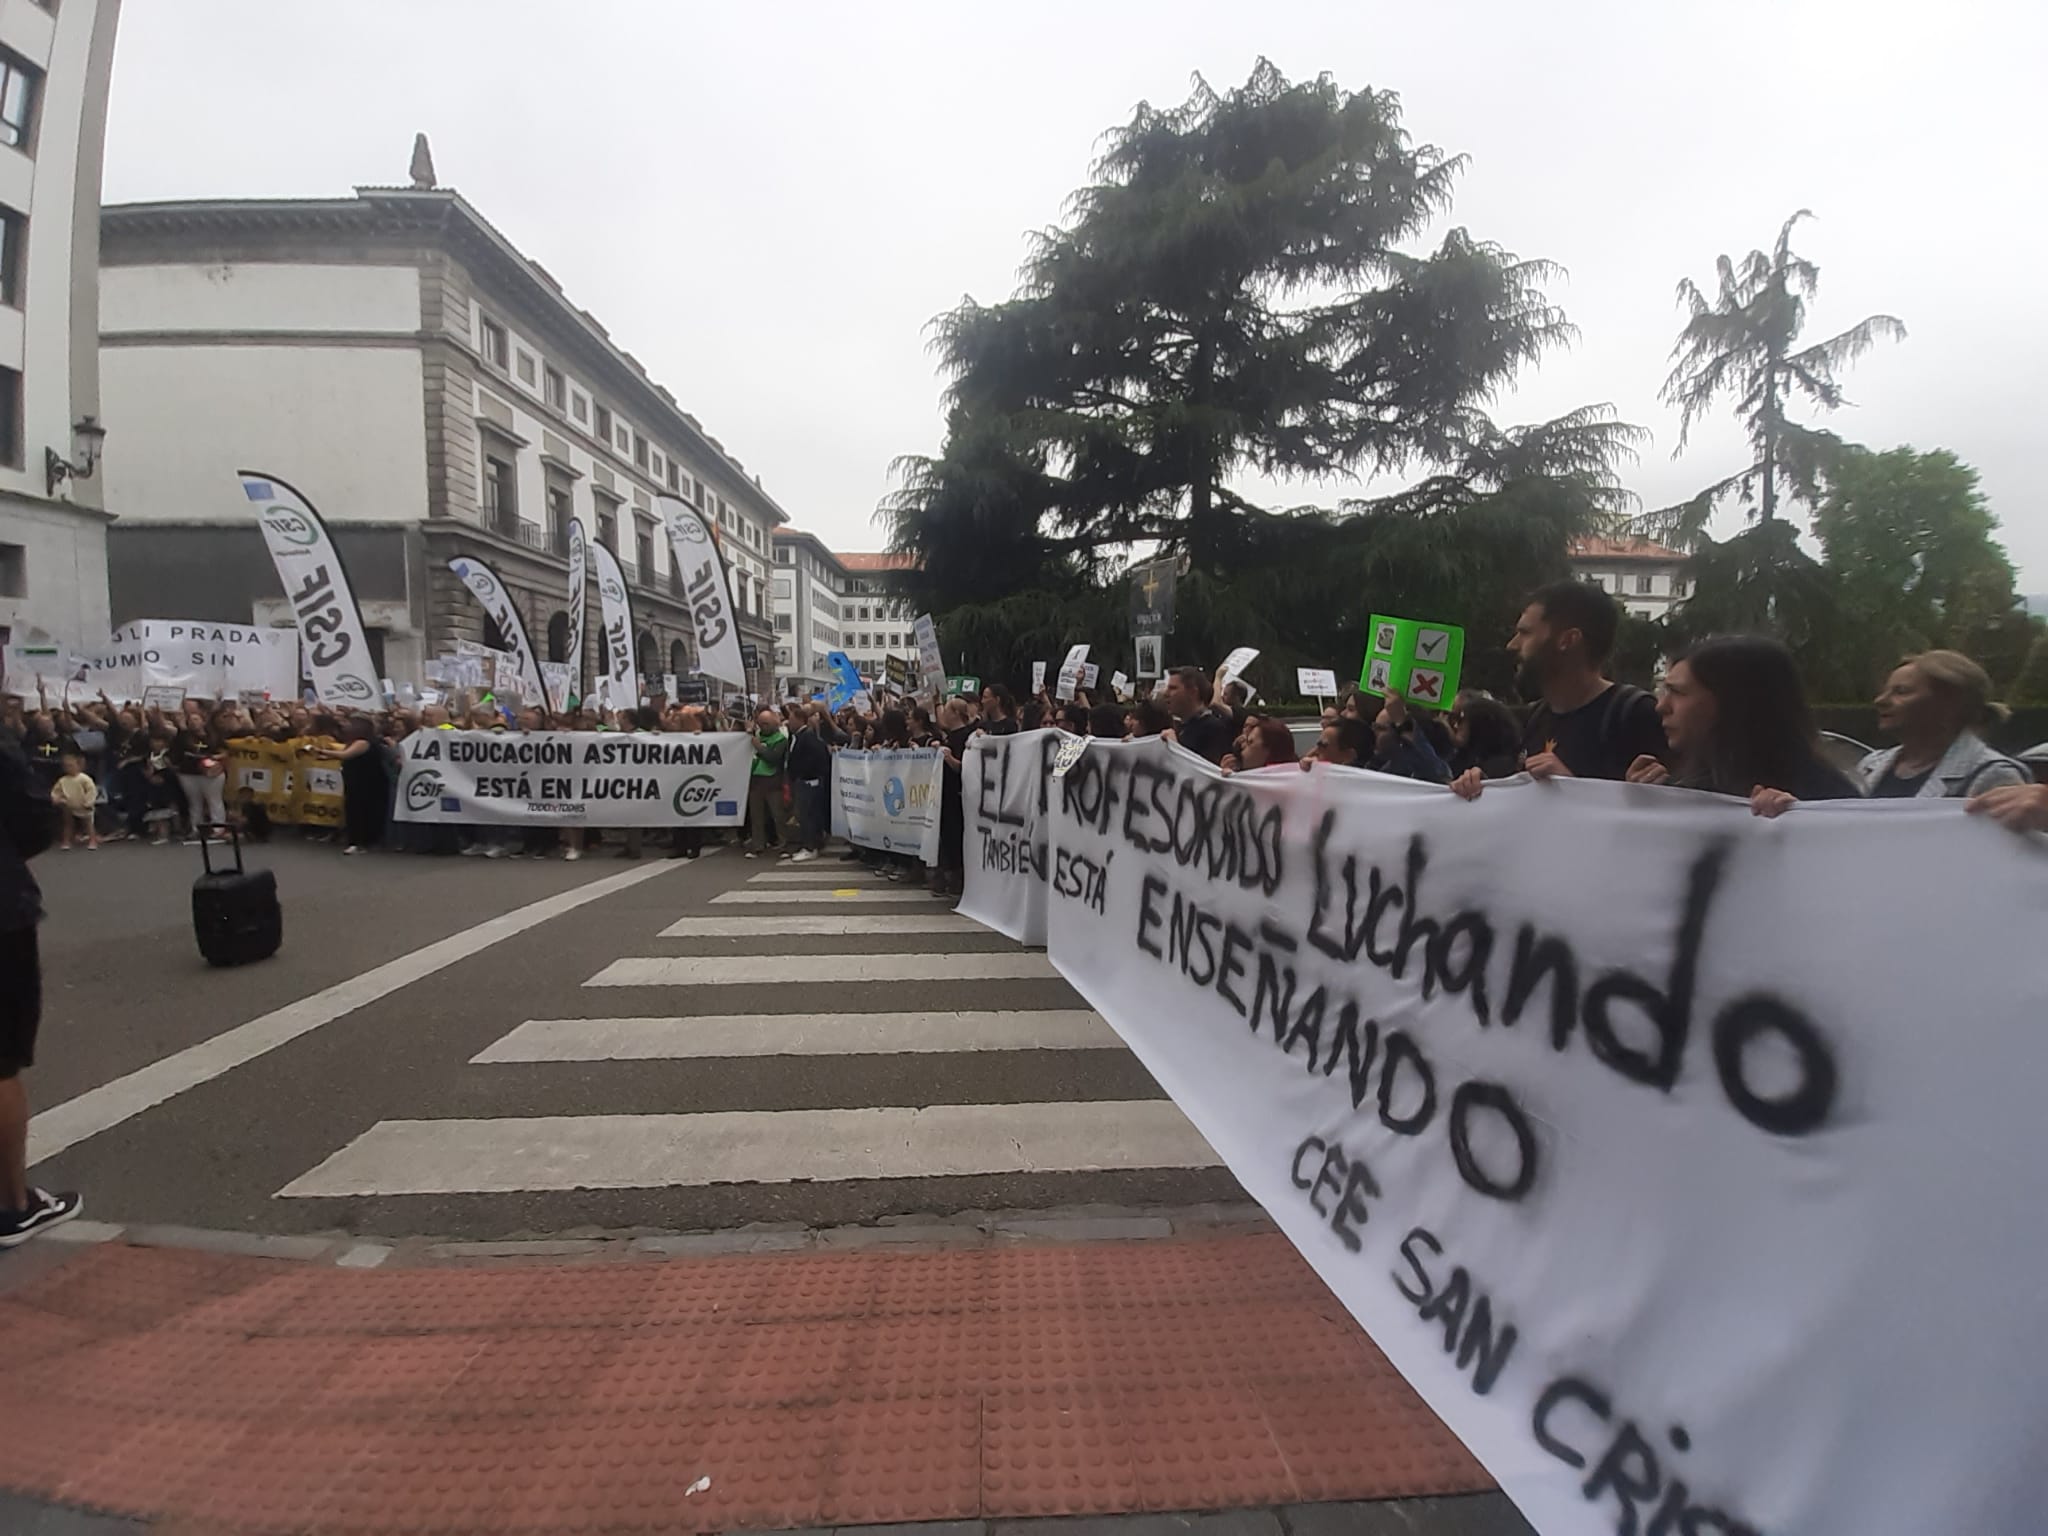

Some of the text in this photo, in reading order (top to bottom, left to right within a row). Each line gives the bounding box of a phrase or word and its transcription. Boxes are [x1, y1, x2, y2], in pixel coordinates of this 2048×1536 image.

[171, 627, 261, 645] PRADA
[192, 652, 235, 667] SIN
[411, 736, 722, 765] LA EDUCACIÓN ASTURIANA
[411, 782, 446, 797] CSIF
[475, 771, 661, 800] ESTÁ EN LUCHA
[683, 787, 721, 802] CSIF
[978, 743, 1025, 827] EL
[1053, 850, 1114, 916] ESTÁ
[1137, 873, 1537, 1201] ENSEÑANDO
[1291, 1135, 1382, 1253] CEE
[1391, 1226, 1518, 1395] SAN
